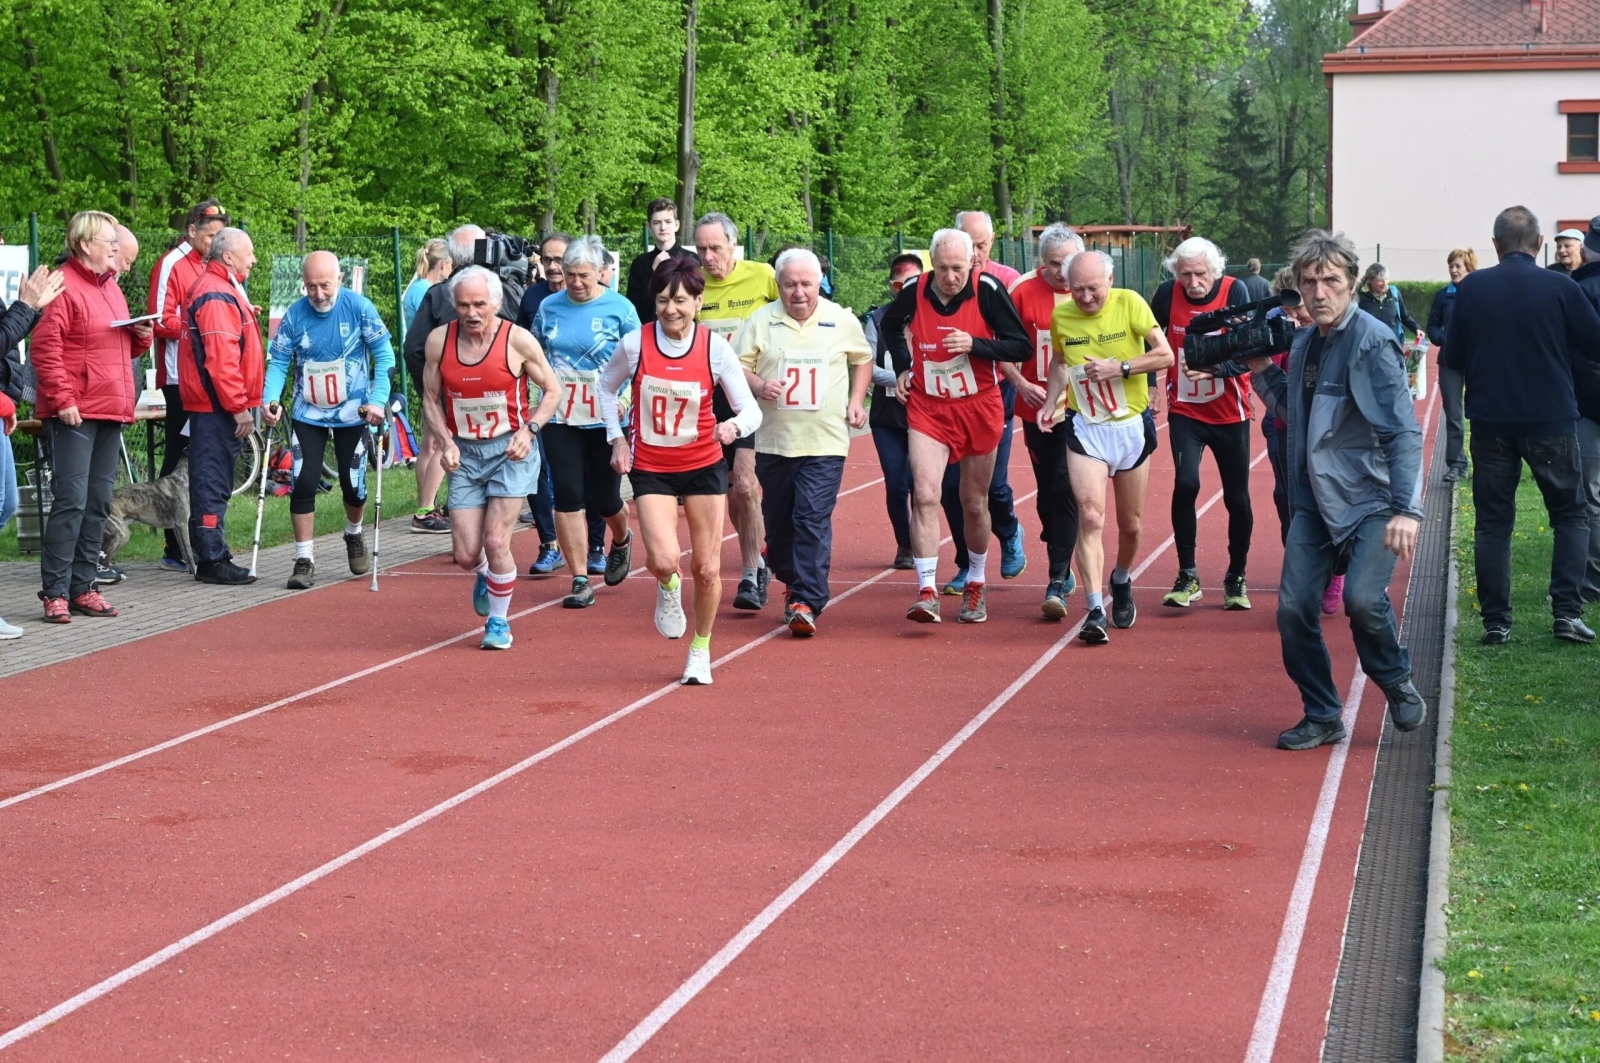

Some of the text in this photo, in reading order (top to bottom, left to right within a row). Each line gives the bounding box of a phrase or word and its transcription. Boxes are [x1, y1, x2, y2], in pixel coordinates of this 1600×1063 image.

[309, 373, 338, 405] 10
[565, 383, 595, 419] 74
[648, 384, 669, 394] PIVOVAR
[670, 388, 693, 397] TRUTNOV
[785, 367, 816, 405] 21
[1079, 378, 1118, 417] 70
[652, 395, 689, 437] 87
